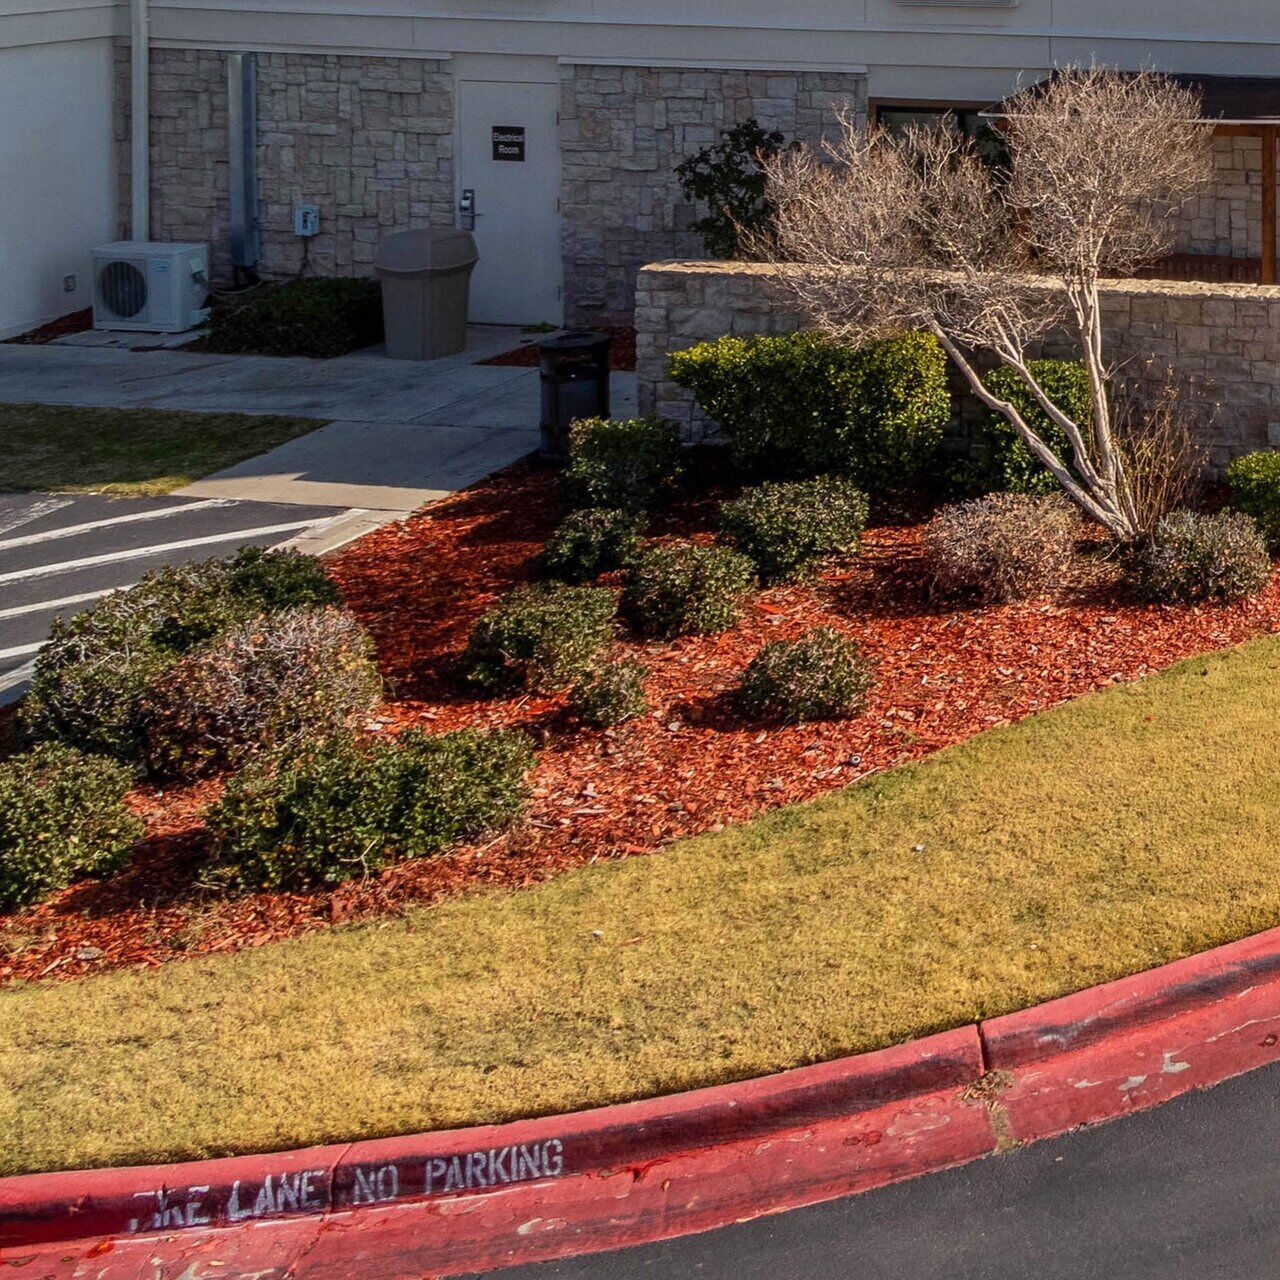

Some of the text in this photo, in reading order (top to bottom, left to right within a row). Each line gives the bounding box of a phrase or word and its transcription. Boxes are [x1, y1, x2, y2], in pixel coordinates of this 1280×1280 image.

[498, 144, 520, 154] Room
[227, 1169, 325, 1222] LANE
[353, 1164, 399, 1205] NO
[424, 1138, 564, 1195] PARKING
